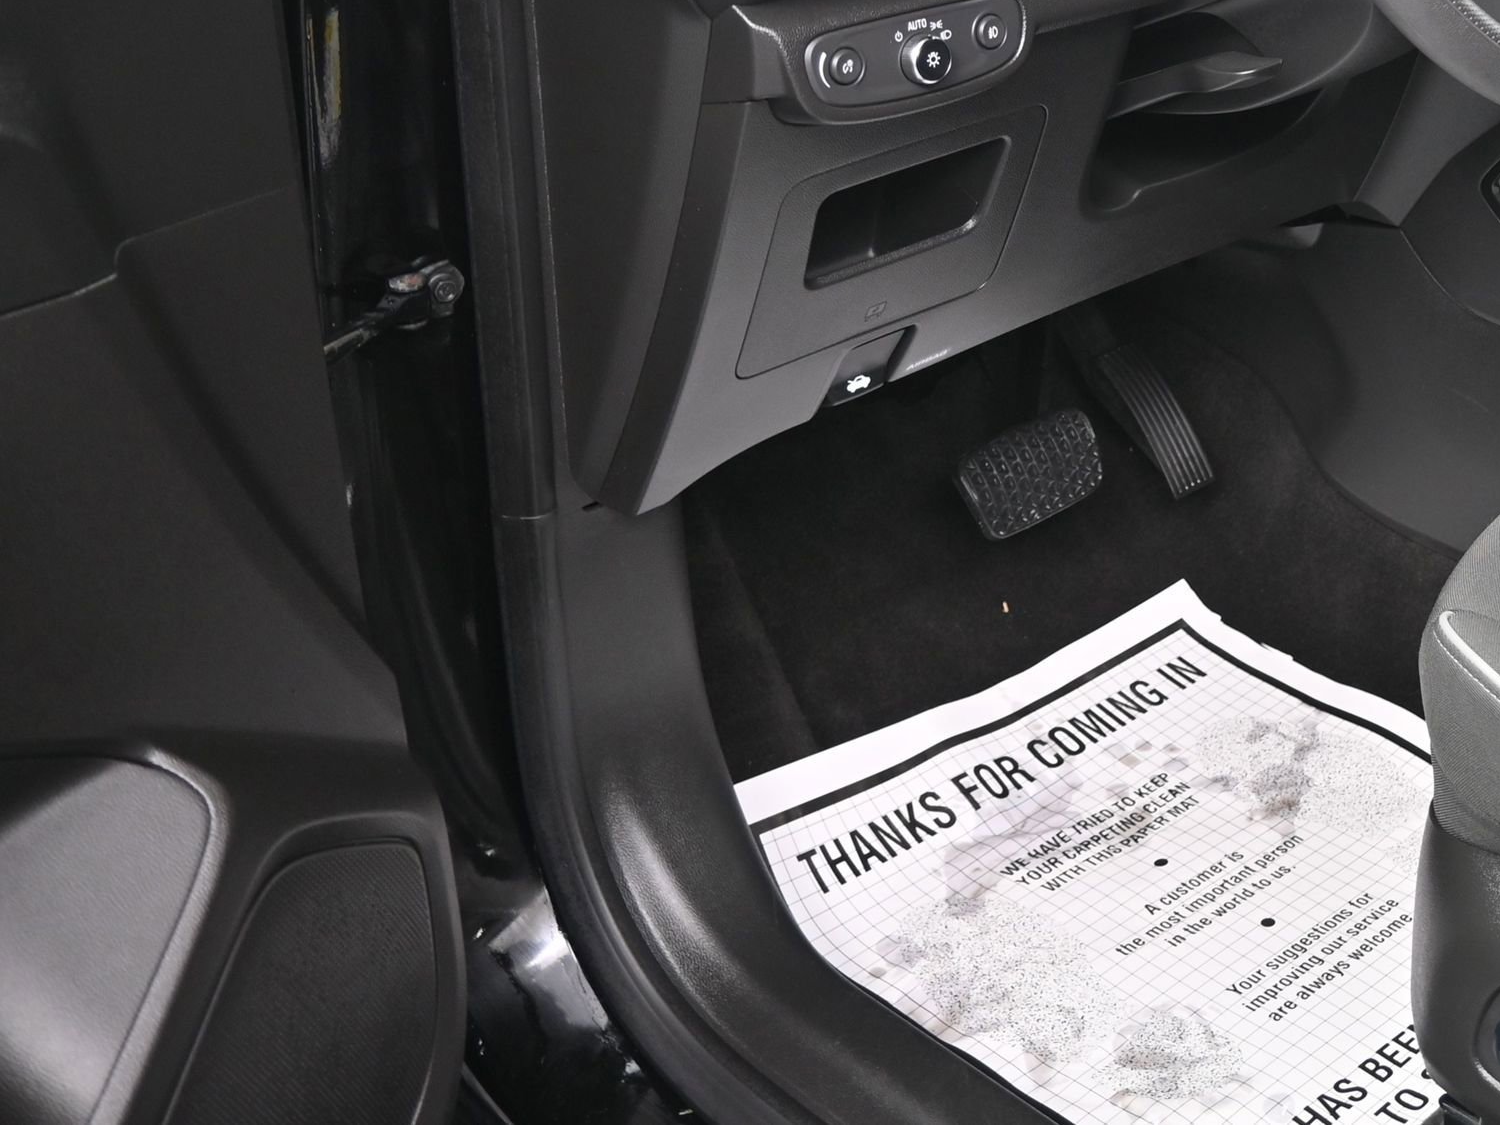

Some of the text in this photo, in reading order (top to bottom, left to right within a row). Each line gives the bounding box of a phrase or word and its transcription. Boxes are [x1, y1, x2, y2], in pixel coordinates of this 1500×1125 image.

[907, 18, 927, 32] AUTO
[796, 656, 1208, 894] THANKS FOR COMING IN
[1000, 772, 1169, 877] WE HAVE TRIED TO KEEP
[1016, 781, 1191, 887] YOUR CARPETING CLEAN
[1041, 795, 1200, 892] WITH THIS PAPER MAT
[1144, 850, 1244, 916] A customer is
[1115, 834, 1304, 956] the most important person
[1164, 865, 1297, 947] in the world to us.
[1226, 892, 1374, 996] Your suggestions for
[1242, 898, 1399, 1012] improving our service
[1268, 913, 1413, 1022] are always welcome
[1292, 1024, 1421, 1125] HAS BEE
[1374, 1088, 1429, 1124] TO
